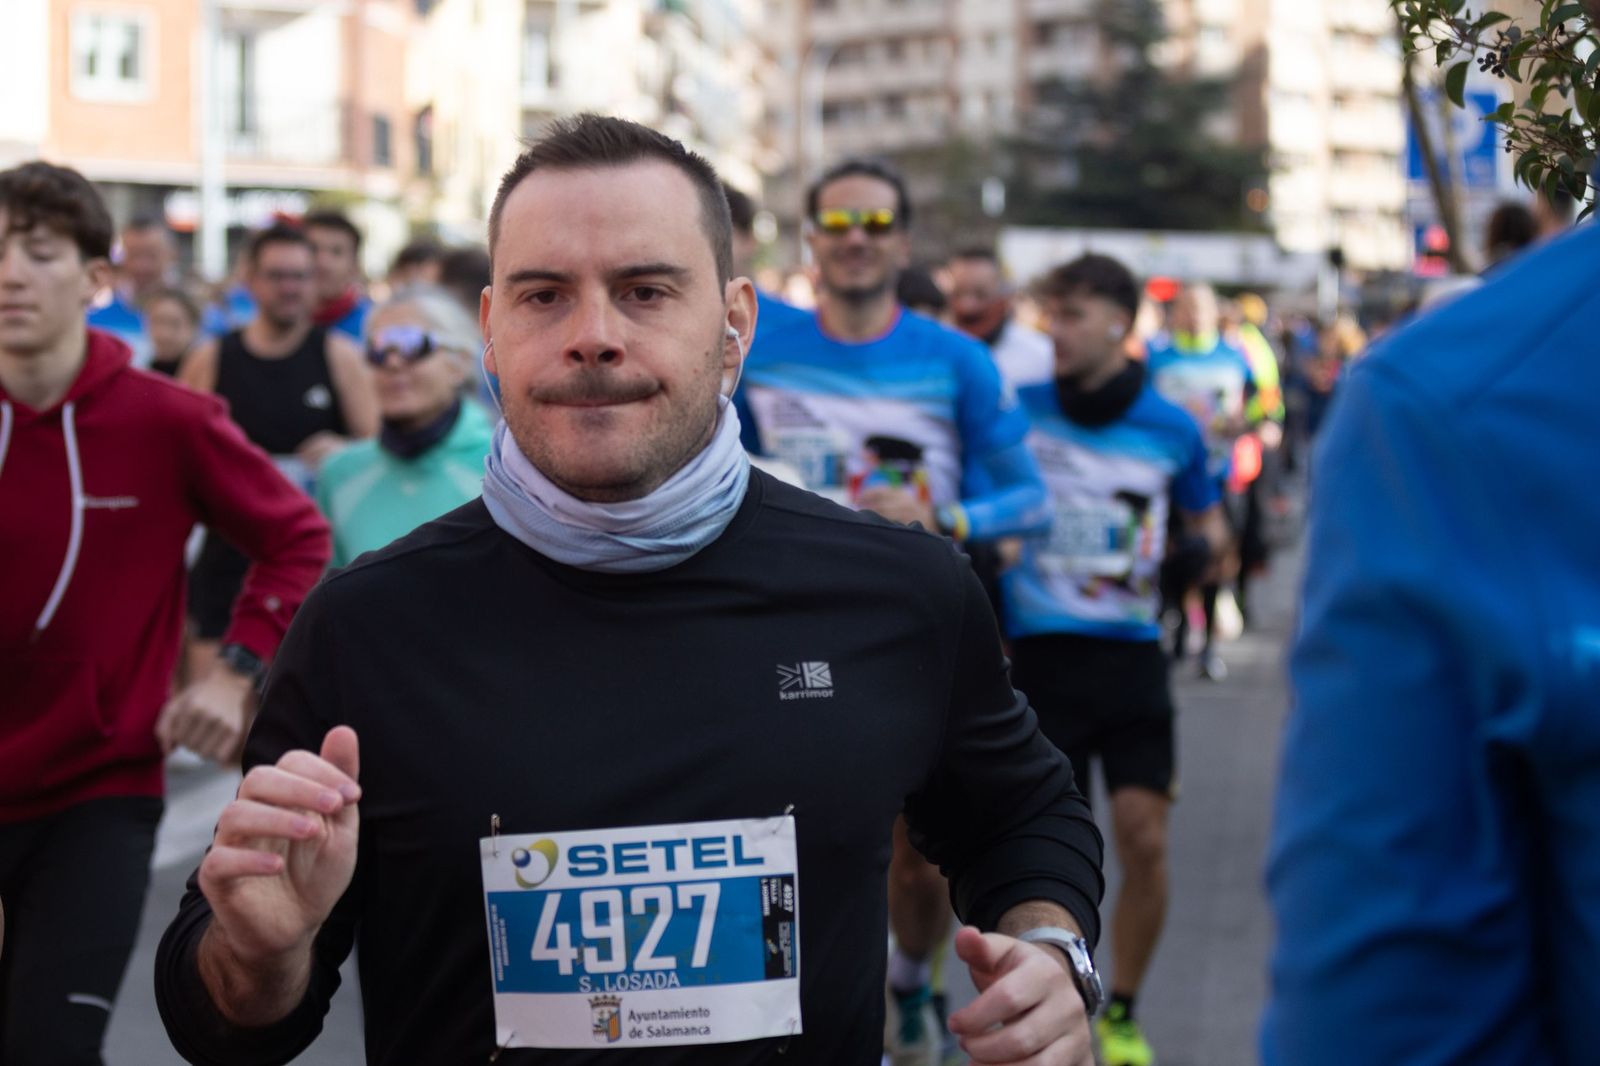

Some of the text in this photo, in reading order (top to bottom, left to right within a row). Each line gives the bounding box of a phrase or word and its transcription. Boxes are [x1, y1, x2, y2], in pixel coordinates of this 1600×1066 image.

[779, 689, 834, 701] karrimor
[567, 834, 765, 878] SETEL
[530, 881, 721, 976] 4927
[627, 1008, 711, 1024] Ayuntamiento
[628, 1024, 711, 1039] de Salamanca
